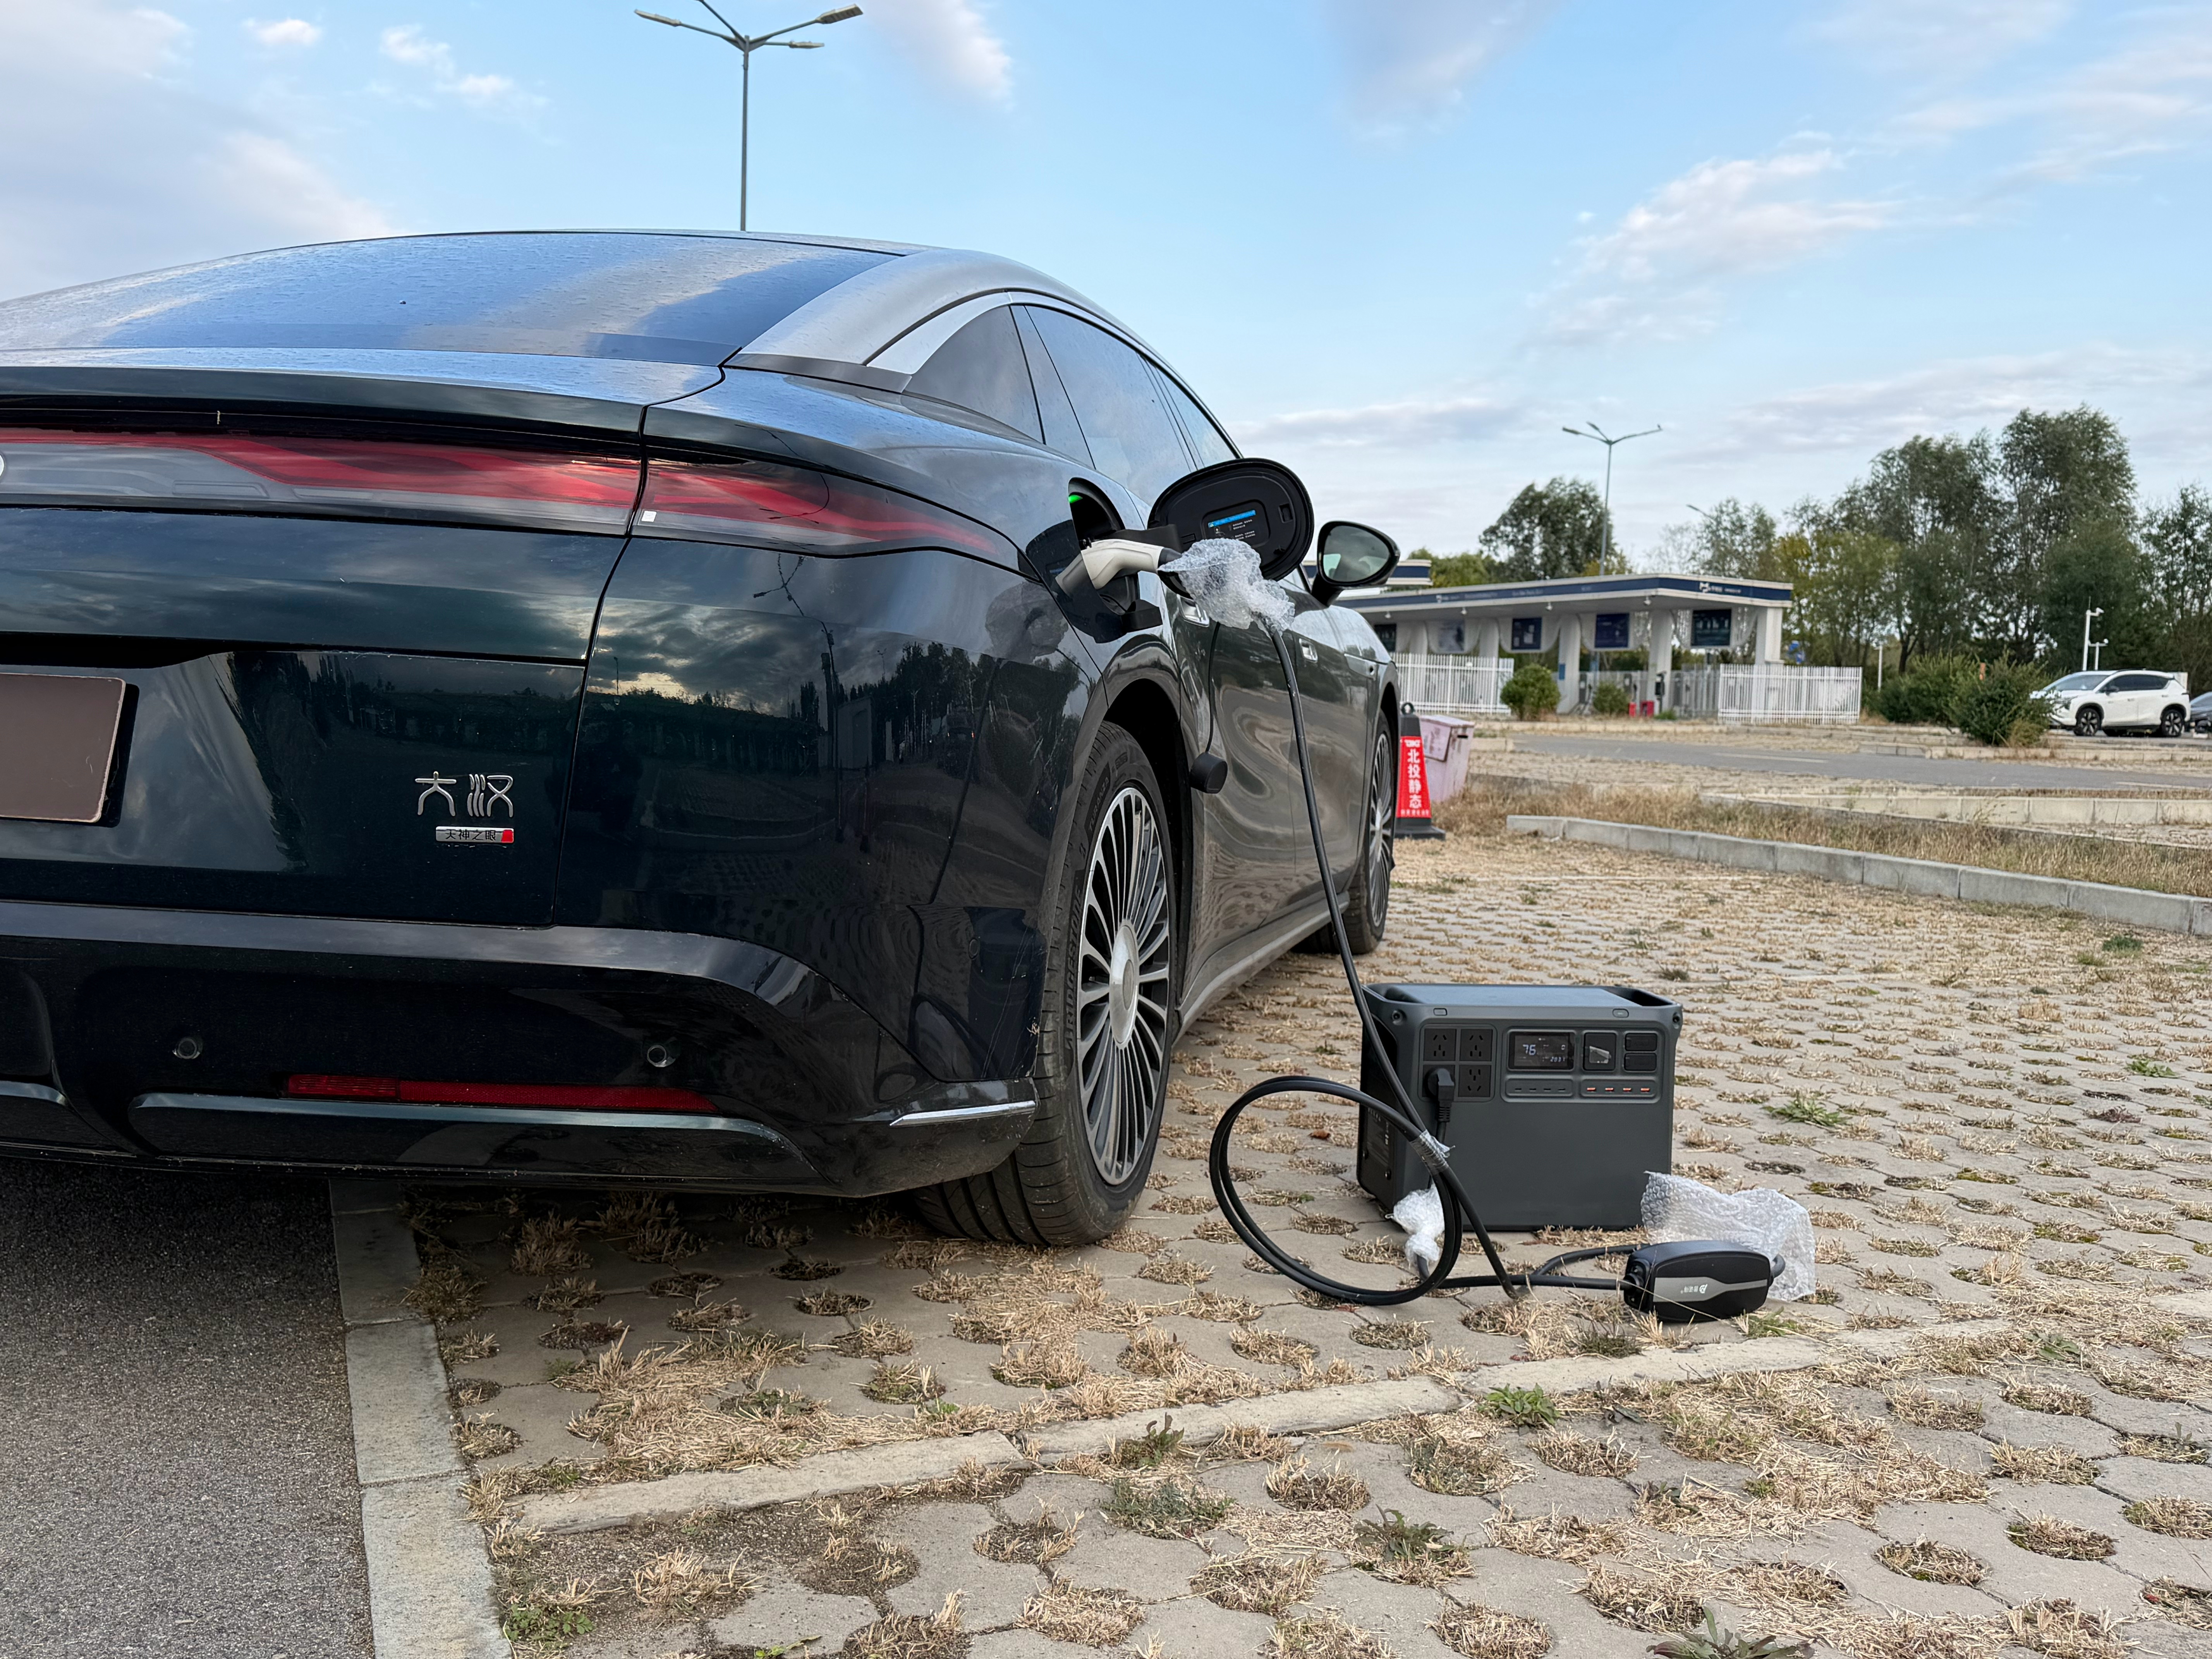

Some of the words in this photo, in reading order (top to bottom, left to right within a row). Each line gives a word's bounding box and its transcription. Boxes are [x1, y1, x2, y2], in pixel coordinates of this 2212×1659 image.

[415, 771, 513, 817] 大汉
[1089, 776, 1109, 832] TURANZA
[1407, 748, 1422, 809] 北投静态
[445, 829, 496, 841] 天神之眼
[1065, 884, 1081, 1050] BRIDGESTONE
[1522, 1044, 1536, 1056] 76
